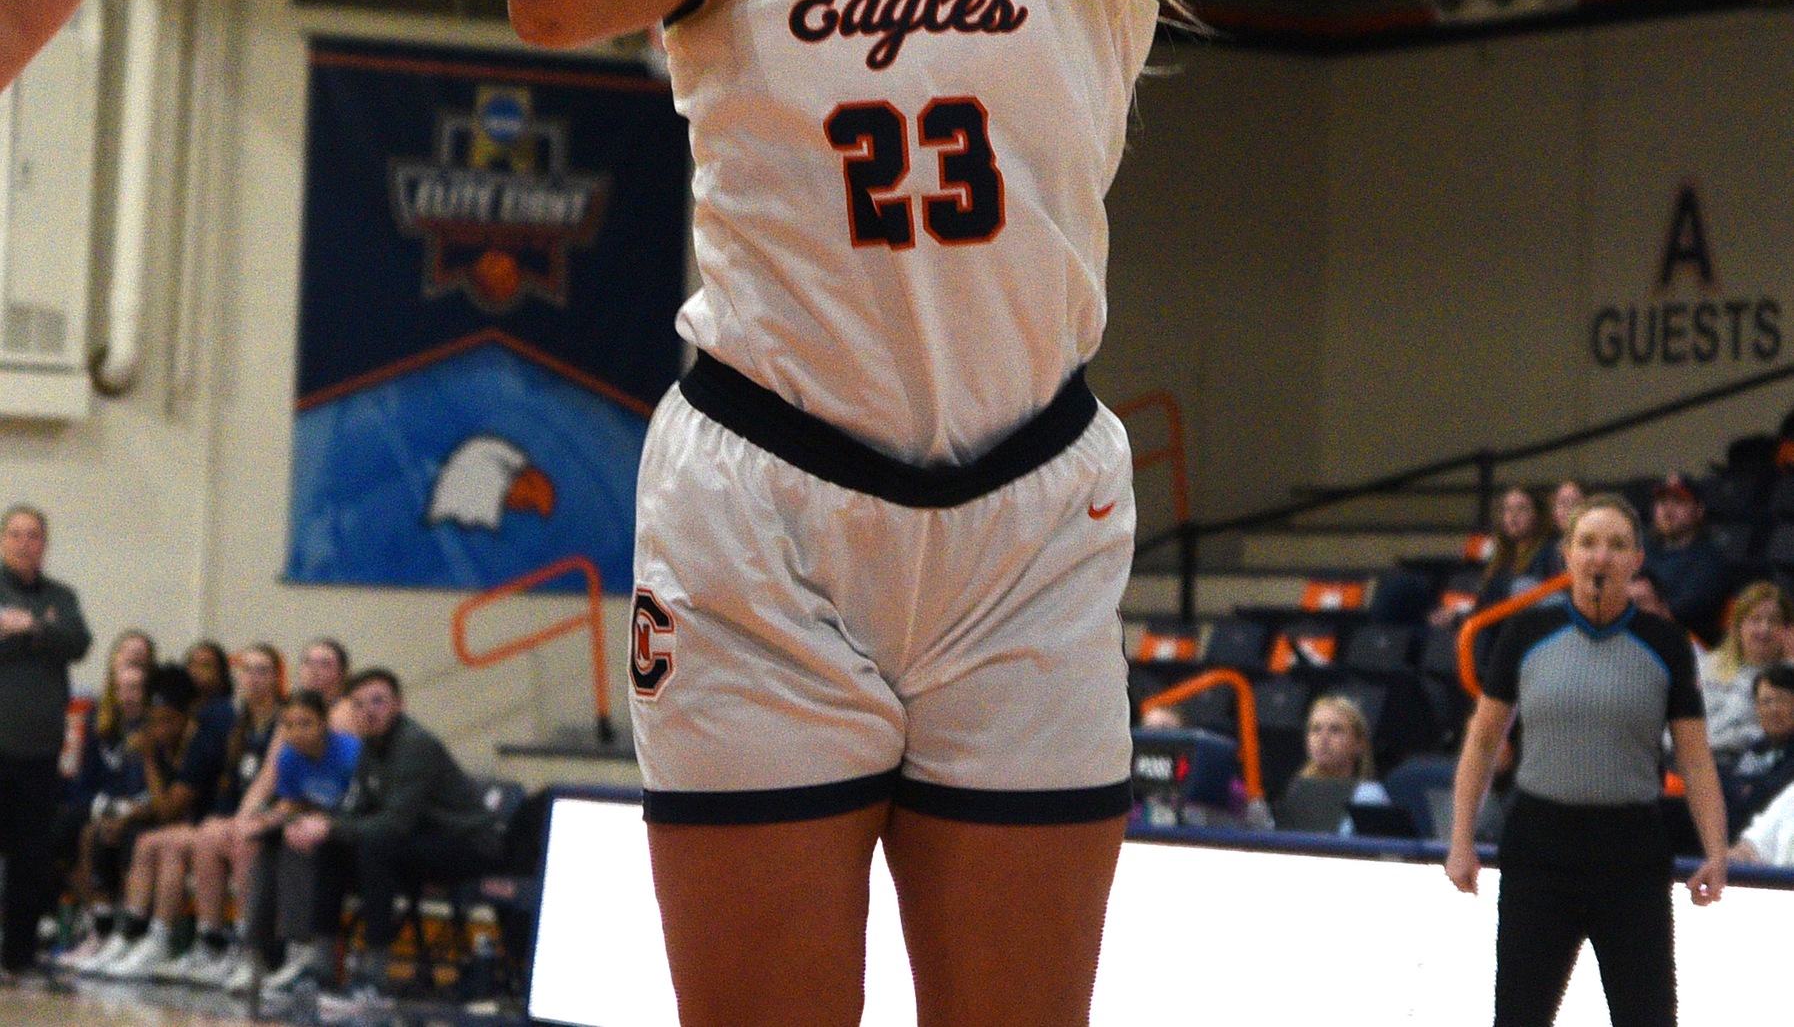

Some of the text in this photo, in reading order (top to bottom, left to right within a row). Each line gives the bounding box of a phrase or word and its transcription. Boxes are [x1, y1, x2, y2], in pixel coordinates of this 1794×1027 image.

[823, 96, 1006, 251] 23
[1659, 184, 1717, 288] A
[1592, 298, 1782, 367] GUESTS
